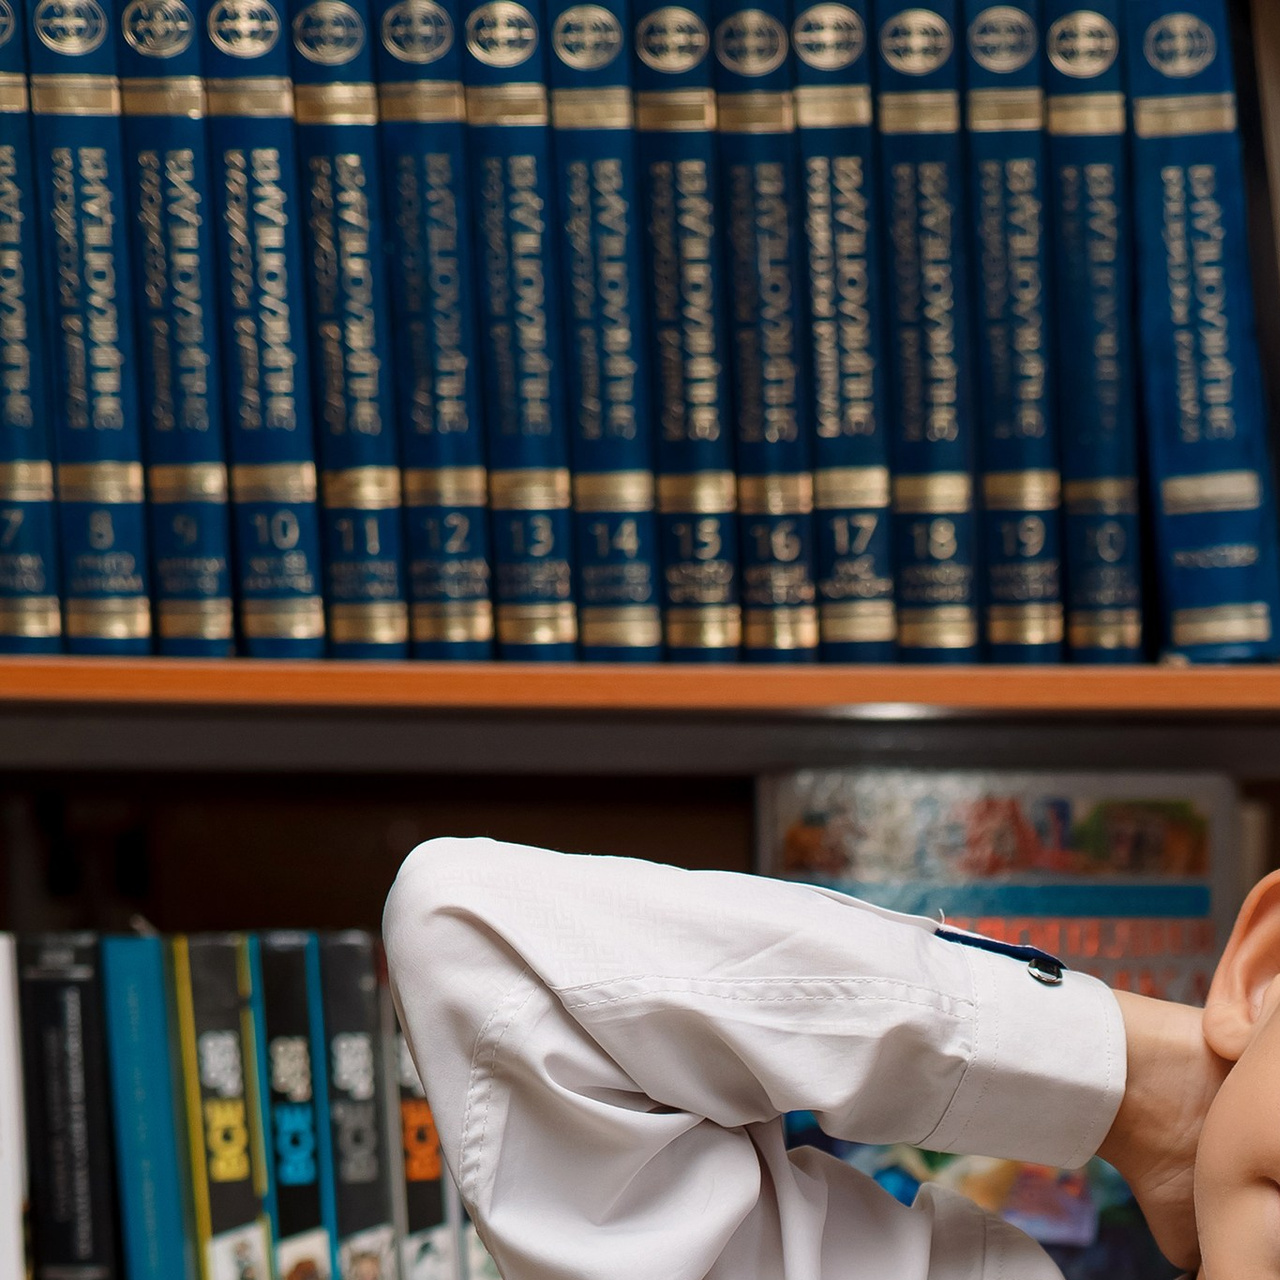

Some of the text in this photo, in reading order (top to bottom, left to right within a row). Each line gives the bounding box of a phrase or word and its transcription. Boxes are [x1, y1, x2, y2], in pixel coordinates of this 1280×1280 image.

[0, 509, 25, 549] 7
[88, 510, 116, 551] 8
[248, 509, 300, 551] 10
[335, 515, 381, 556] 11
[424, 511, 471, 555] 12
[509, 514, 555, 558] 13
[589, 518, 639, 560] 14
[674, 517, 722, 560] 15
[750, 519, 801, 562] 16
[830, 513, 879, 556] 17
[911, 517, 958, 560] 18
[1000, 514, 1046, 557] 19
